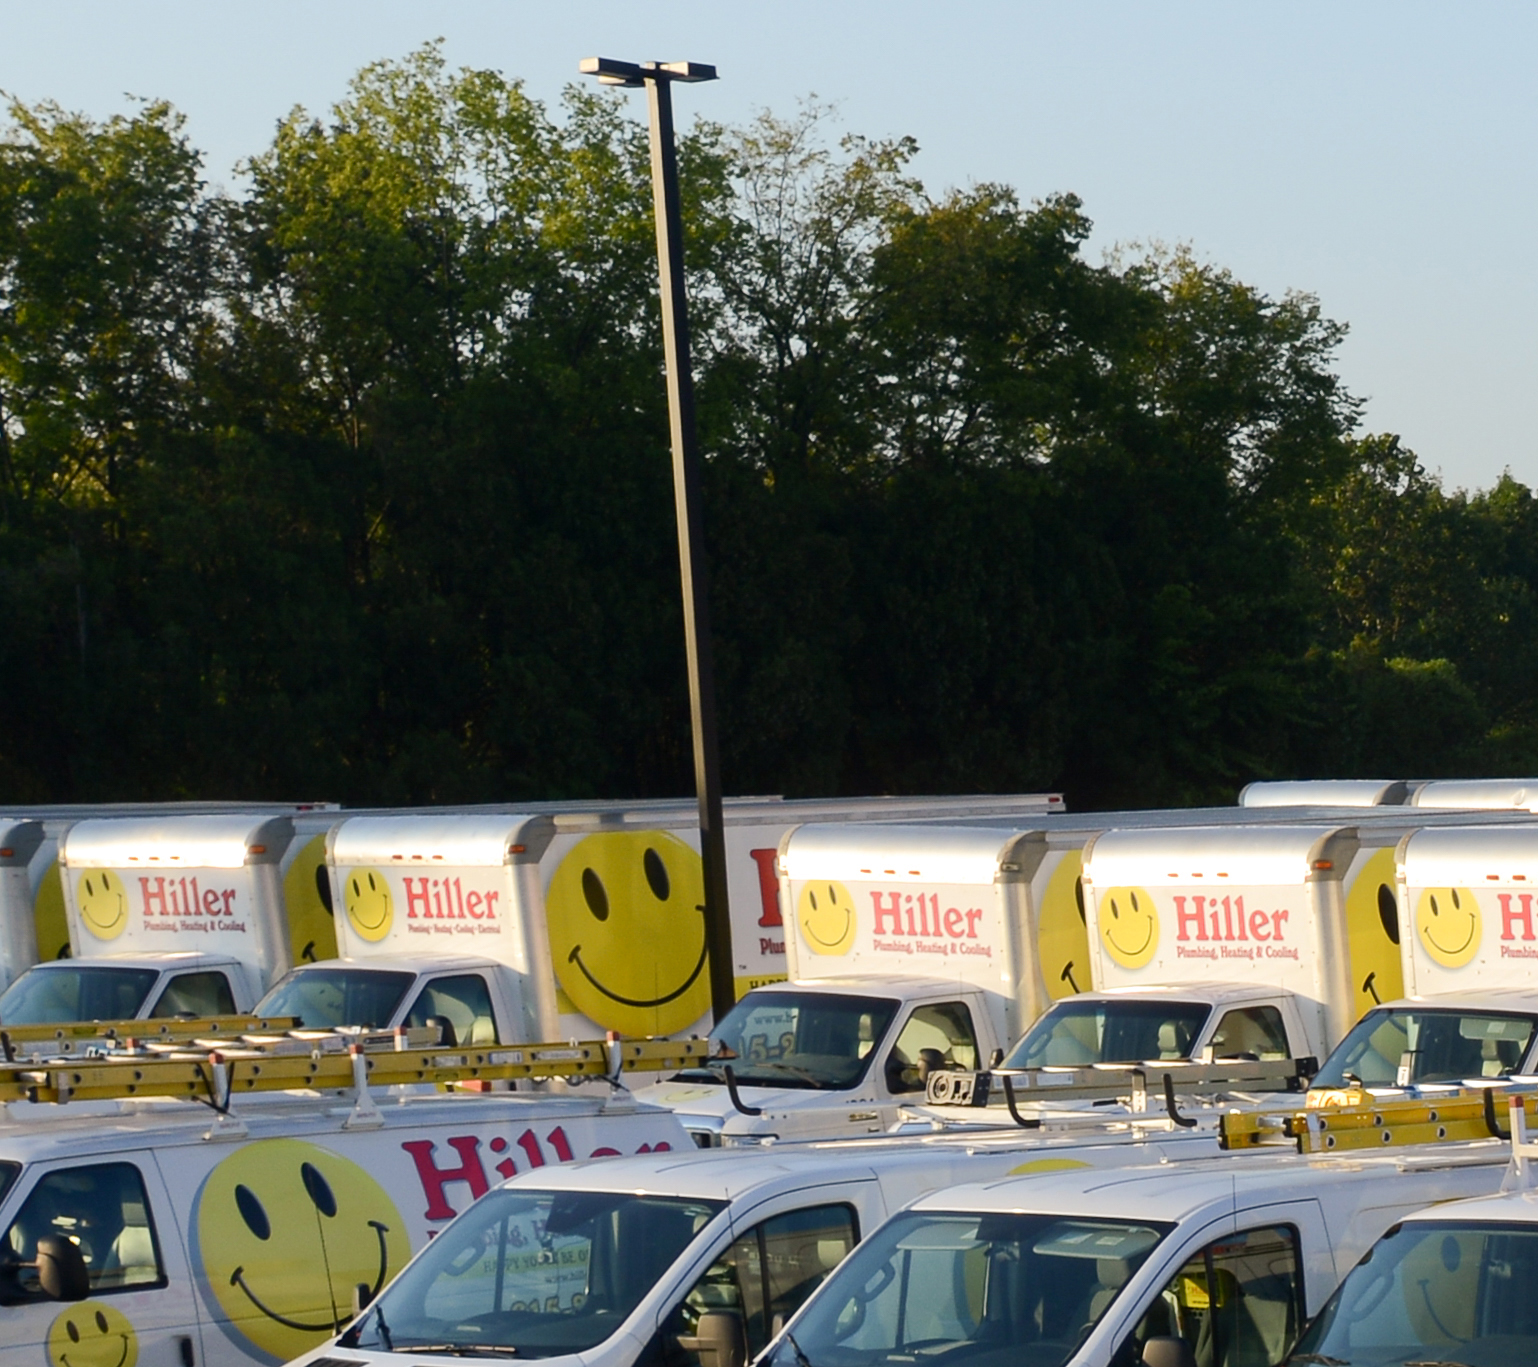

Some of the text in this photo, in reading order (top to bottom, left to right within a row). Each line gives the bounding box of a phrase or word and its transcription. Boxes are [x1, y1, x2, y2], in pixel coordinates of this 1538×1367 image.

[139, 876, 236, 917] Hiller
[402, 876, 499, 919] Hiller
[869, 891, 983, 939] Hiller
[1173, 895, 1290, 942] Hiller
[873, 939, 914, 955] Plumbing,
[916, 941, 950, 956] Heating
[959, 942, 991, 958] Cooling
[1177, 946, 1299, 961] Plumbing, Heating & Cooling
